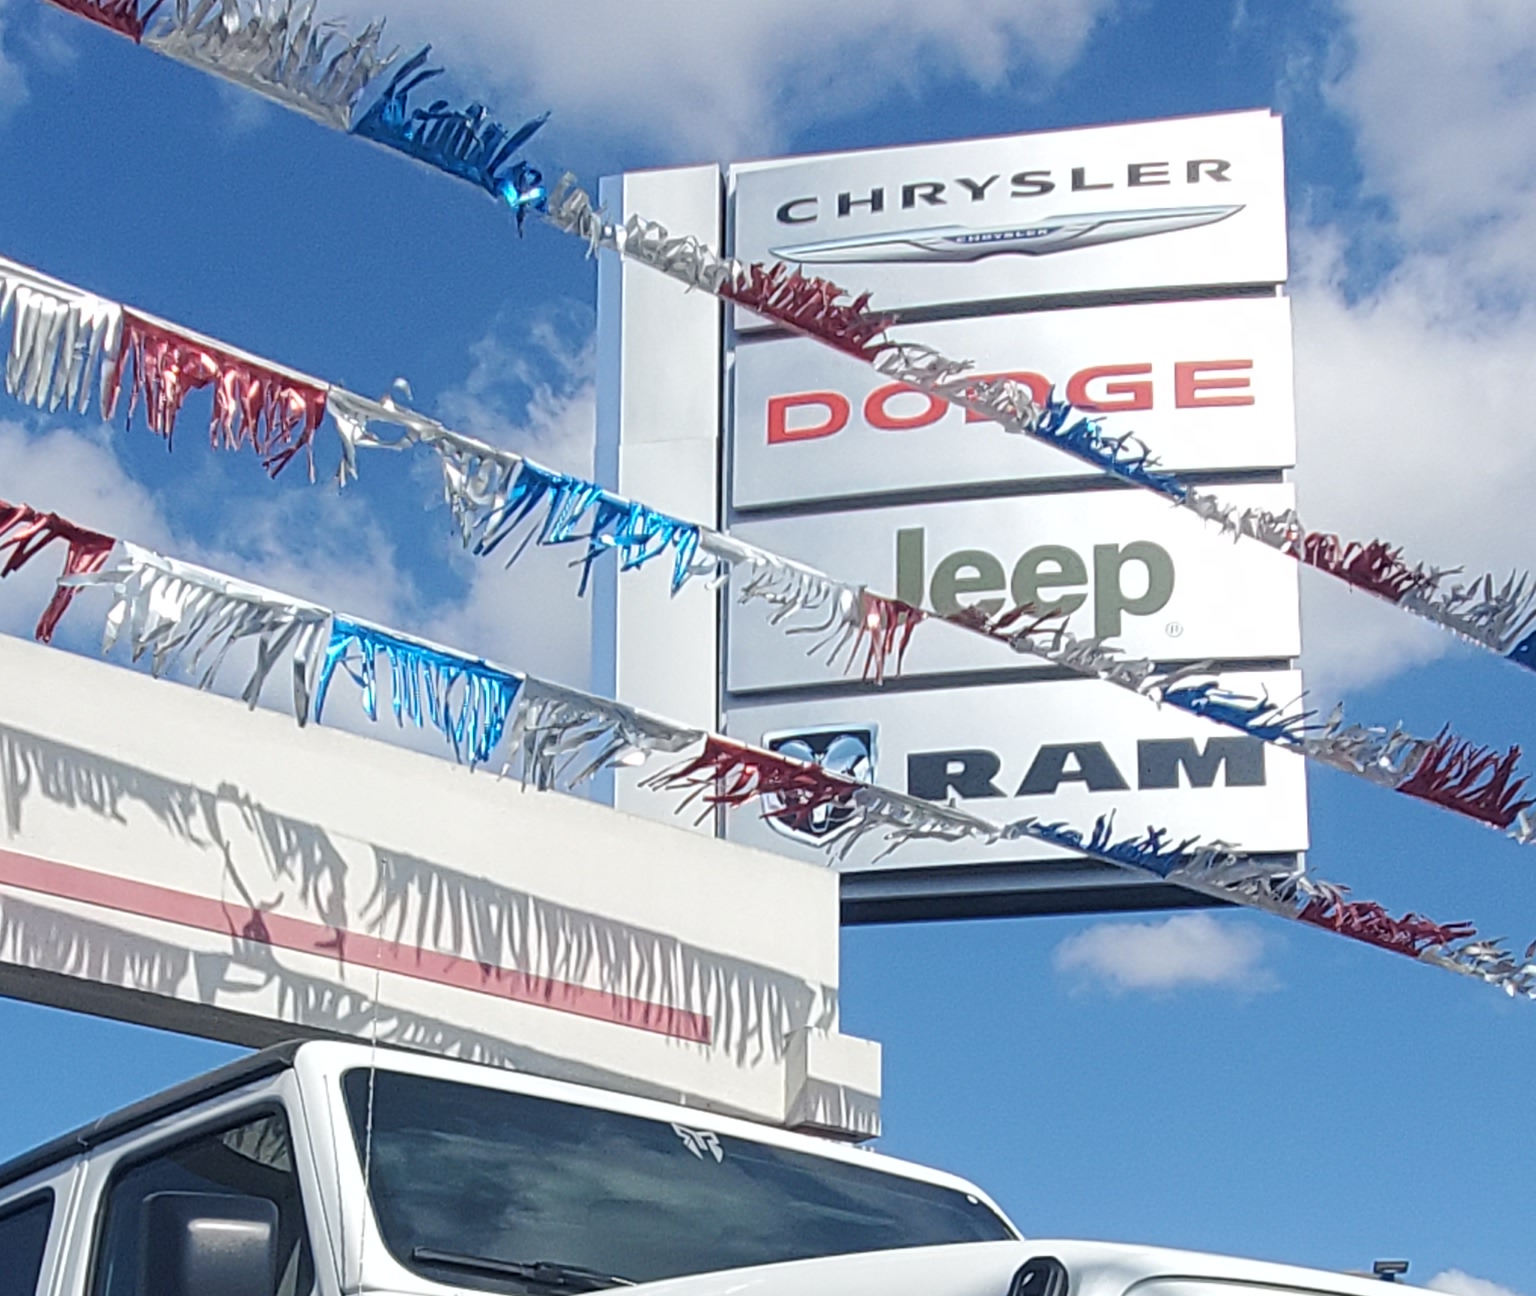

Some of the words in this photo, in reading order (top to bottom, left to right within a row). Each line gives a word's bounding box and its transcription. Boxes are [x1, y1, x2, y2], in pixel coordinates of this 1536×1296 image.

[776, 158, 1233, 224] CHRYSLER
[881, 527, 1175, 638] Jeep
[907, 736, 1267, 800] RAM
